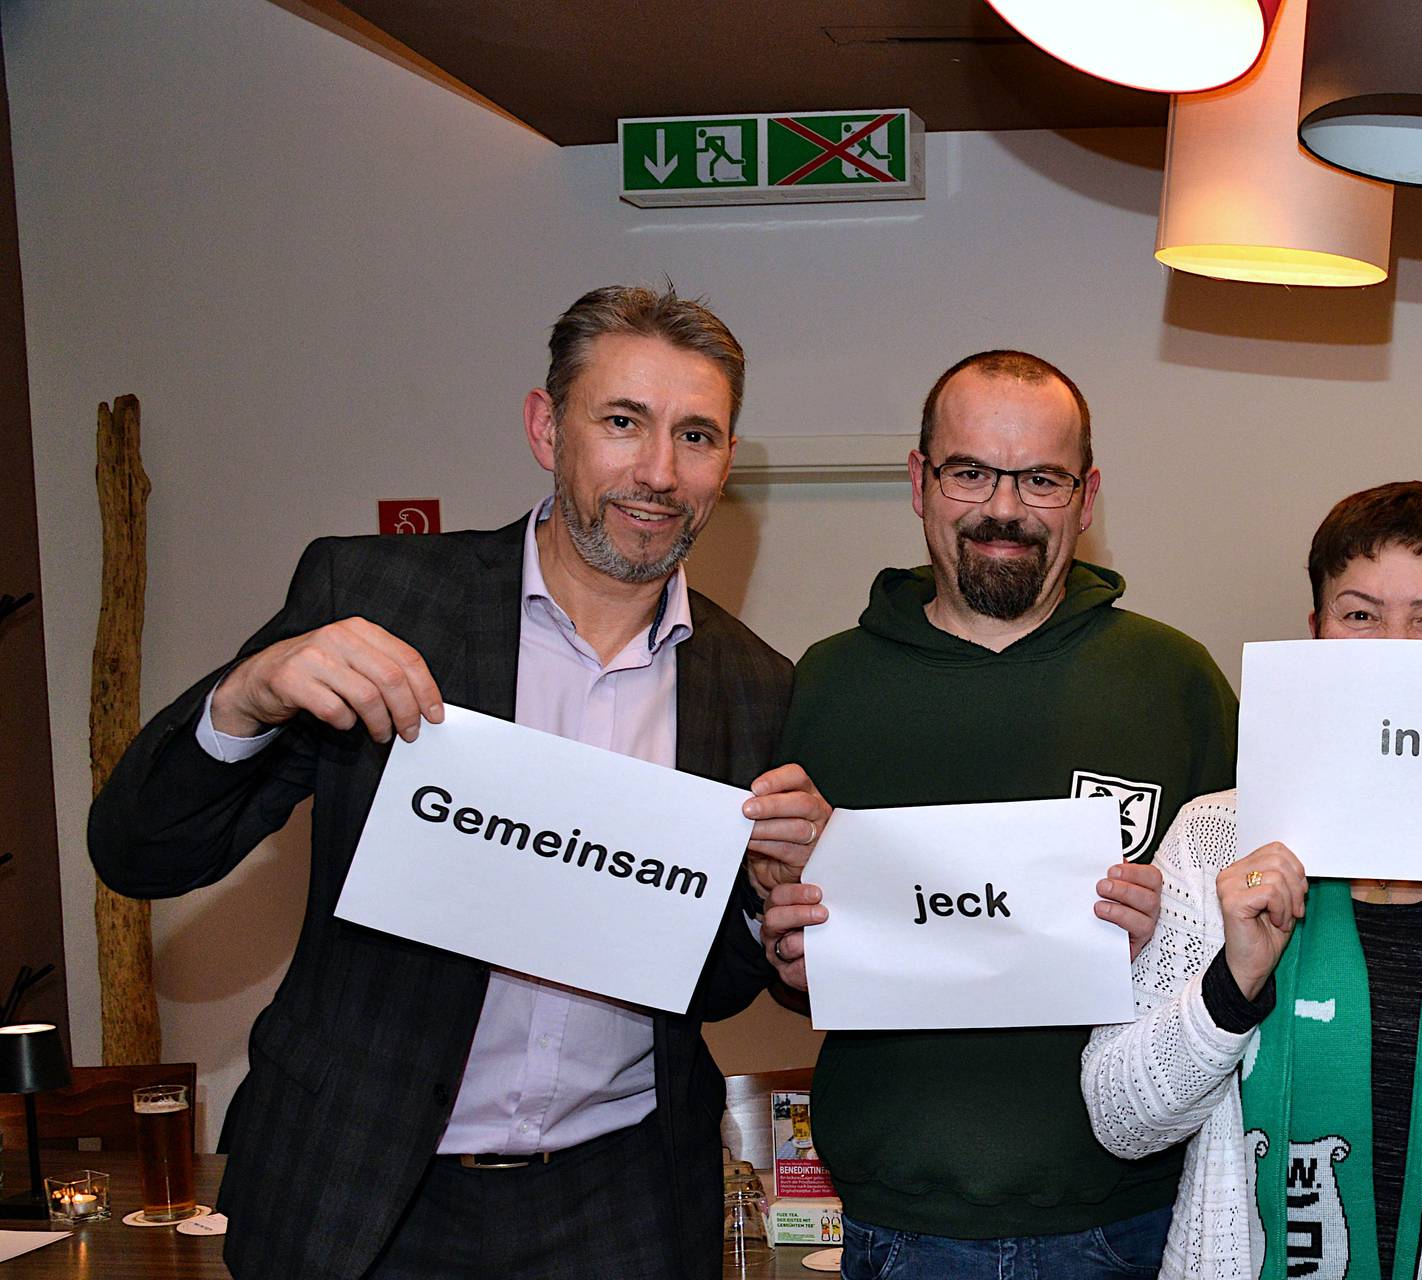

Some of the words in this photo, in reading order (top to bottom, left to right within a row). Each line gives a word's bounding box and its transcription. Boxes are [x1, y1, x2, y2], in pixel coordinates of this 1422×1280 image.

[1381, 719, 1421, 757] in
[411, 785, 708, 899] Gemeinsam
[913, 882, 1011, 925] jeck
